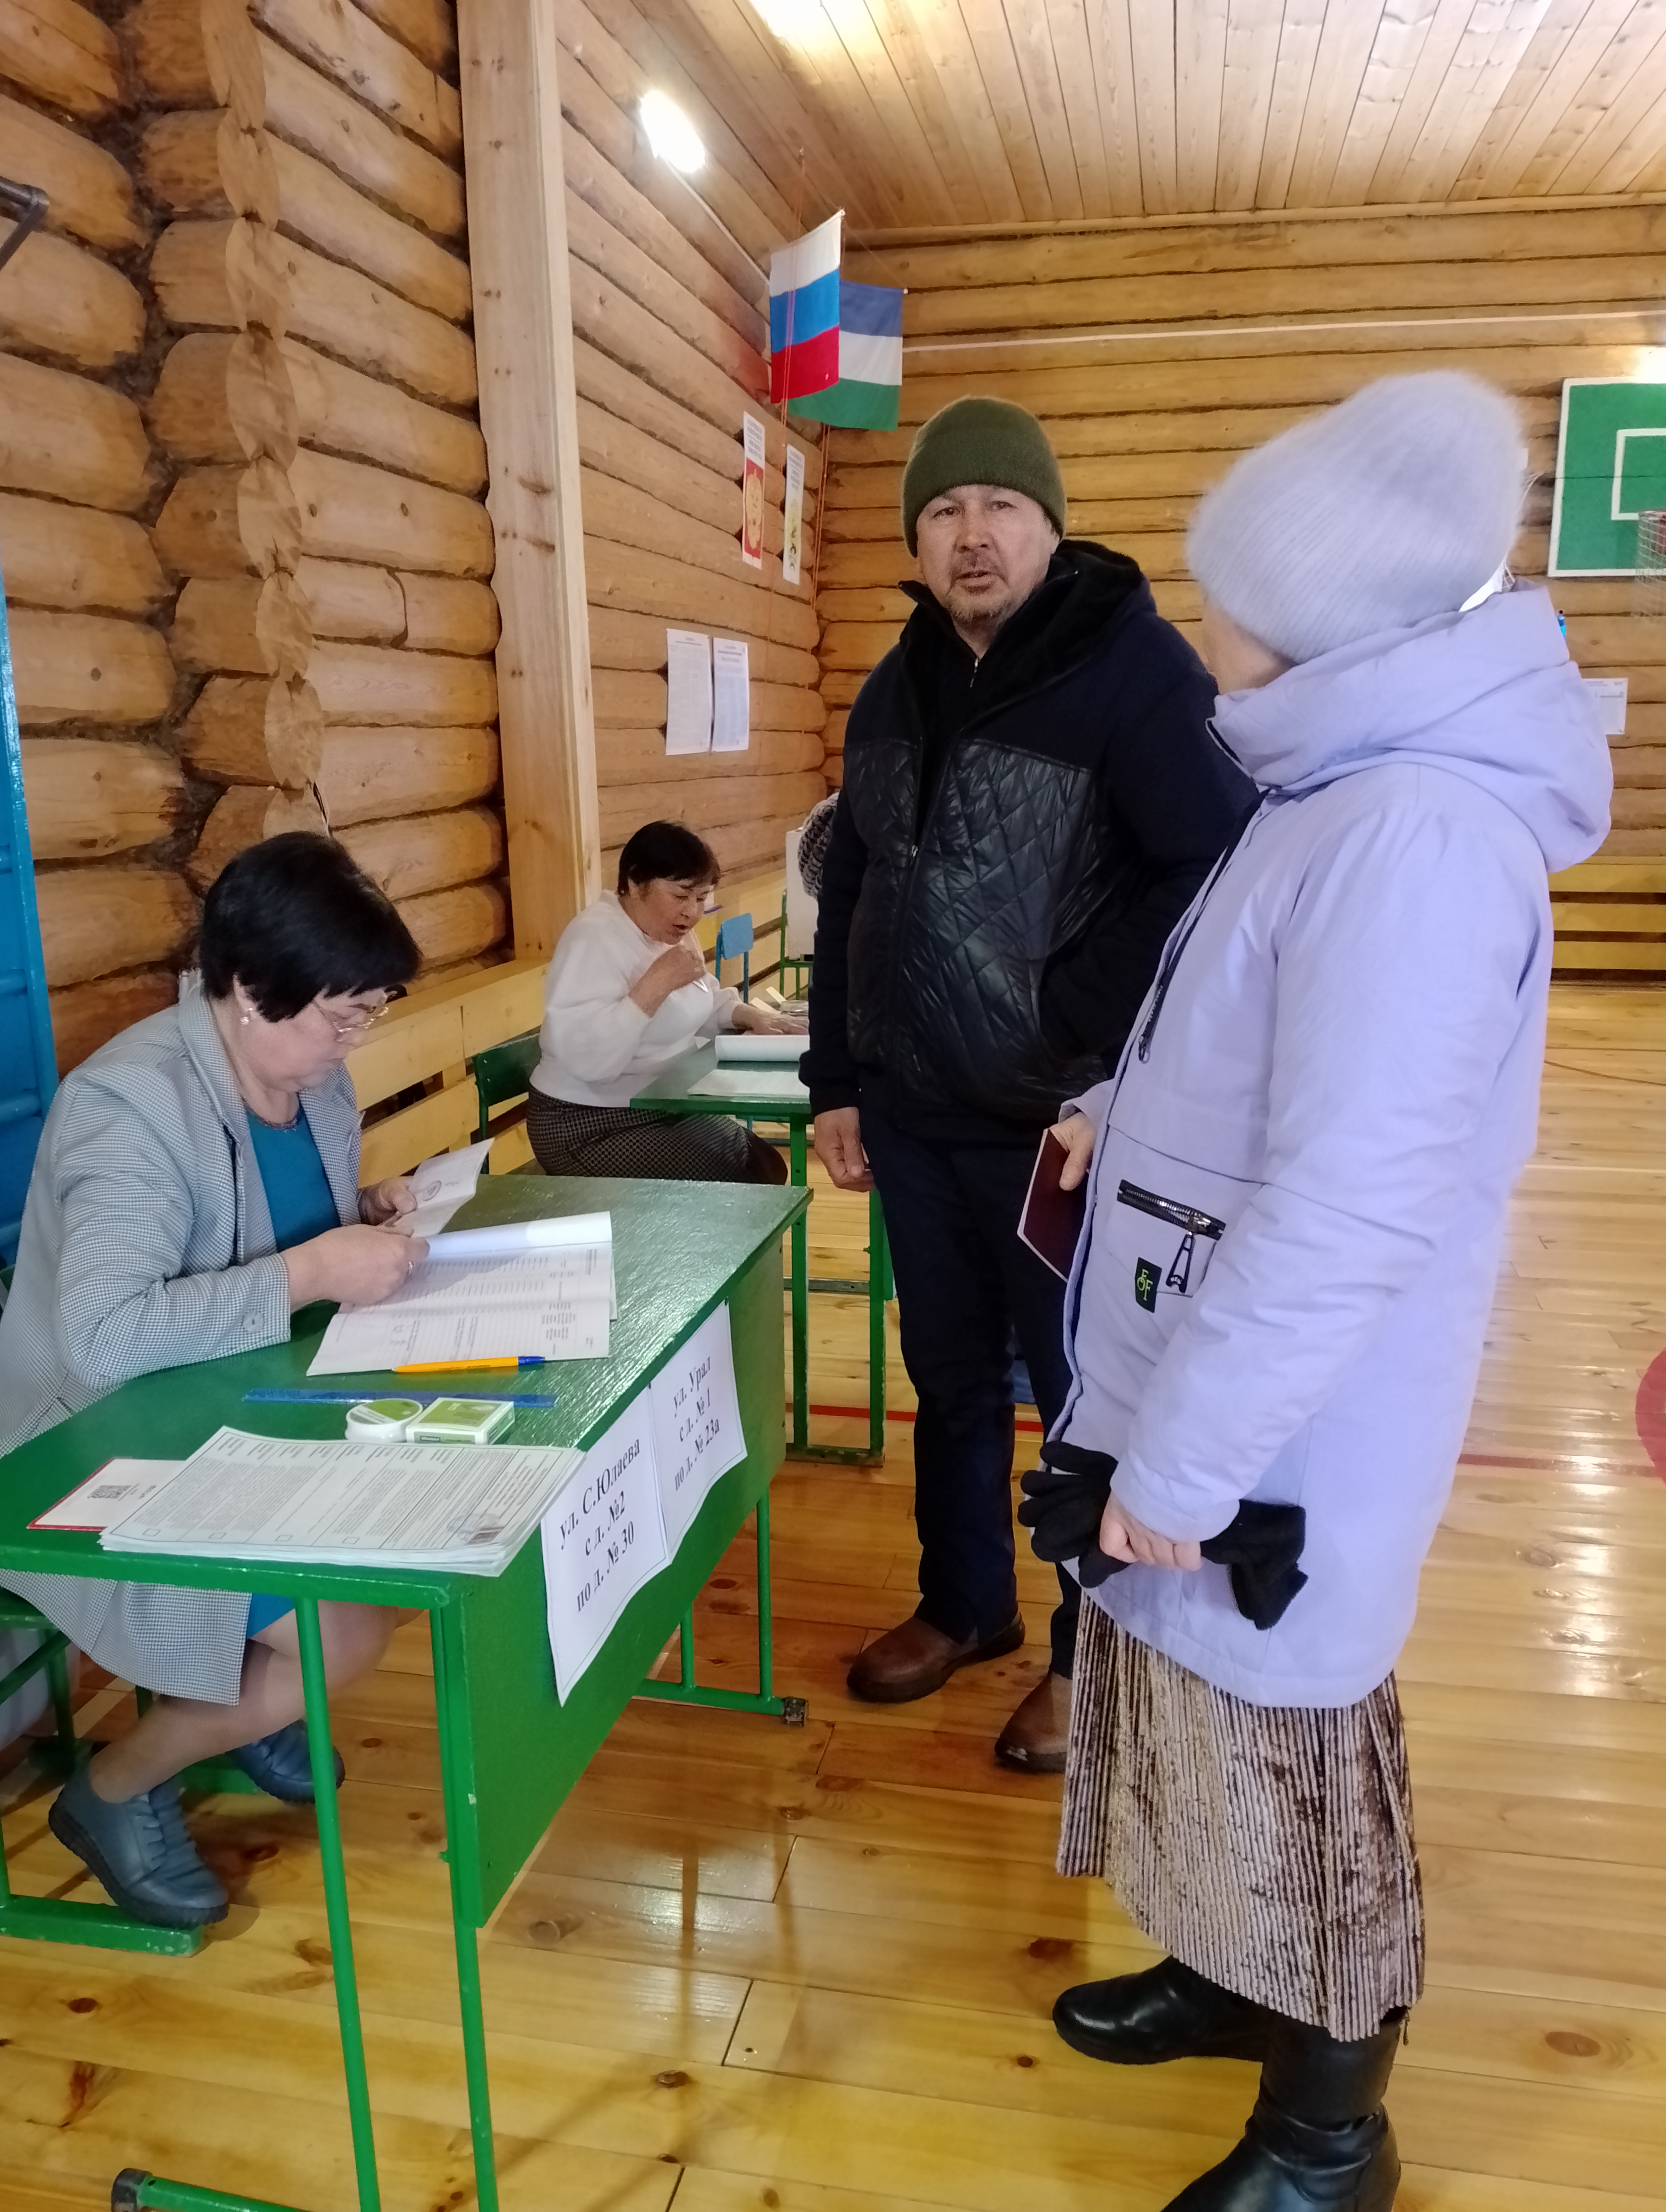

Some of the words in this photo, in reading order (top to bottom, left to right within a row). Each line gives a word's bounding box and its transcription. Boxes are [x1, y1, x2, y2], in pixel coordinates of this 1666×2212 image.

[674, 1387, 687, 1418] ул.
[689, 1356, 710, 1392] Урал
[674, 1466, 684, 1492] по
[705, 1418, 720, 1446] 23а
[680, 1426, 684, 1443] с
[560, 1512, 579, 1549] ул.
[585, 1538, 591, 1557] с
[594, 1526, 605, 1551] д.
[576, 1583, 591, 1613] по
[594, 1569, 604, 1594] д.
[606, 1541, 619, 1574] №
[621, 1521, 634, 1554] 30
